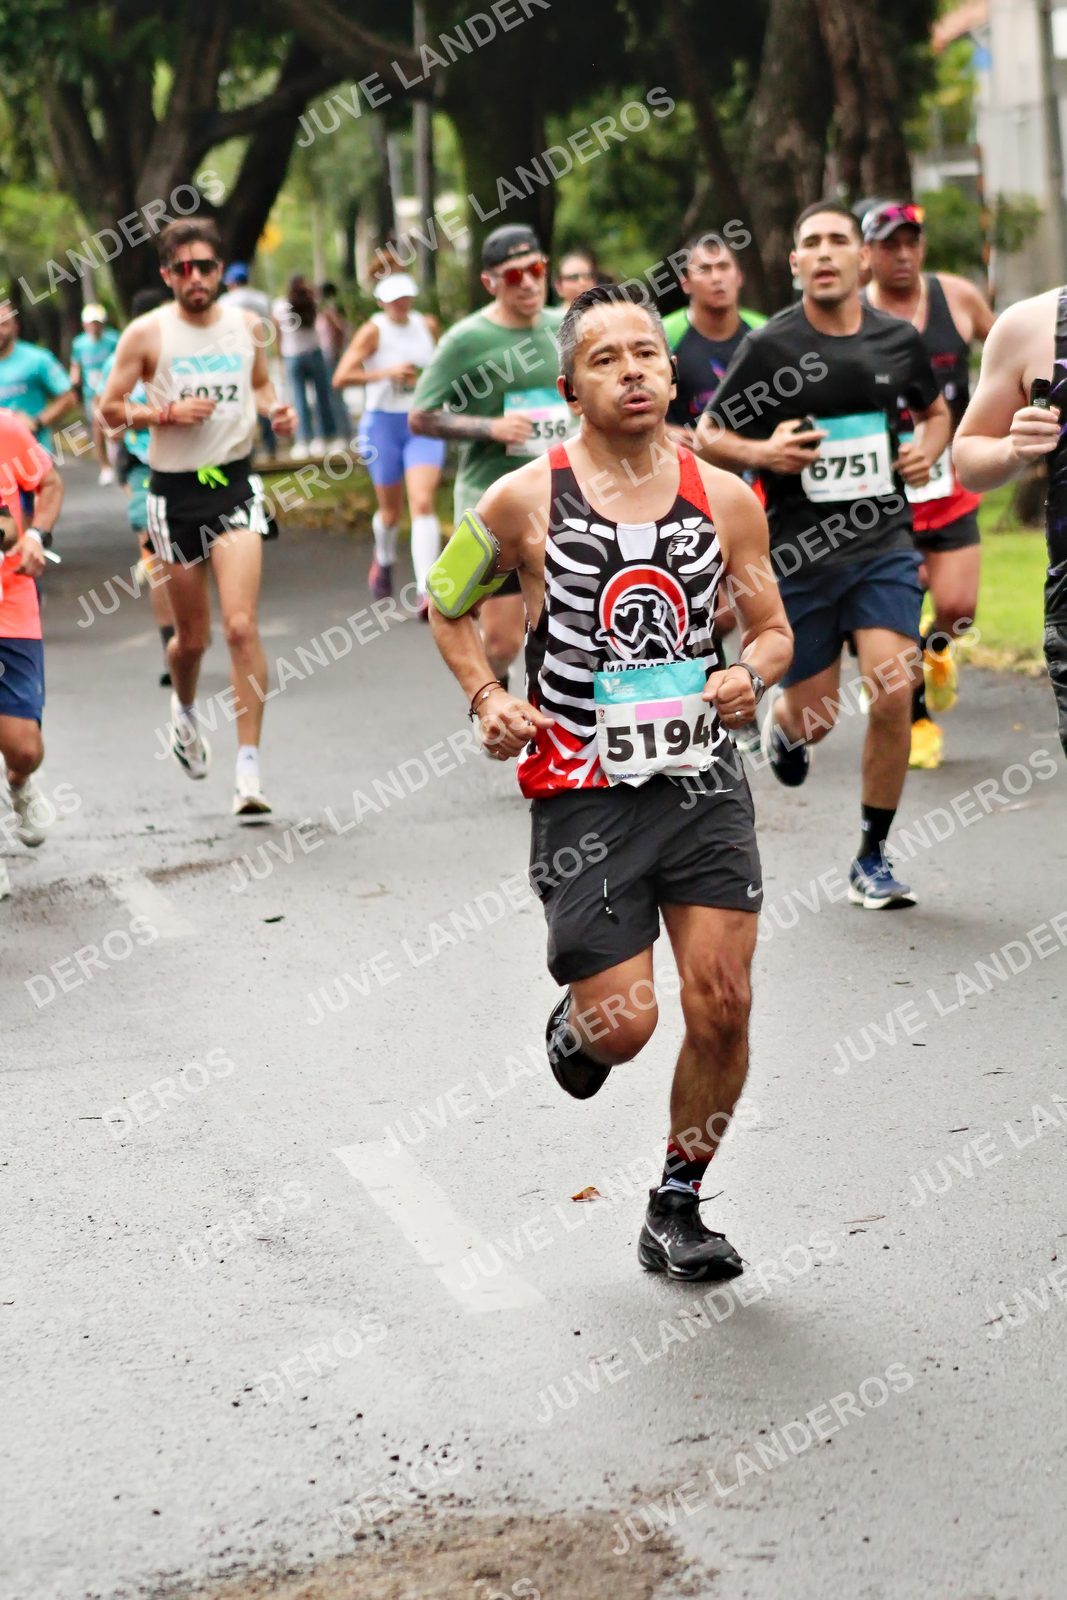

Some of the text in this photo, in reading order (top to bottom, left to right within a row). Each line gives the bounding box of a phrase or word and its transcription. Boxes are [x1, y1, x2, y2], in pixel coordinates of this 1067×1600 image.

[180, 384, 239, 403] 6032
[529, 419, 567, 440] 356
[809, 451, 879, 481] 6751
[606, 713, 711, 762] 5194
